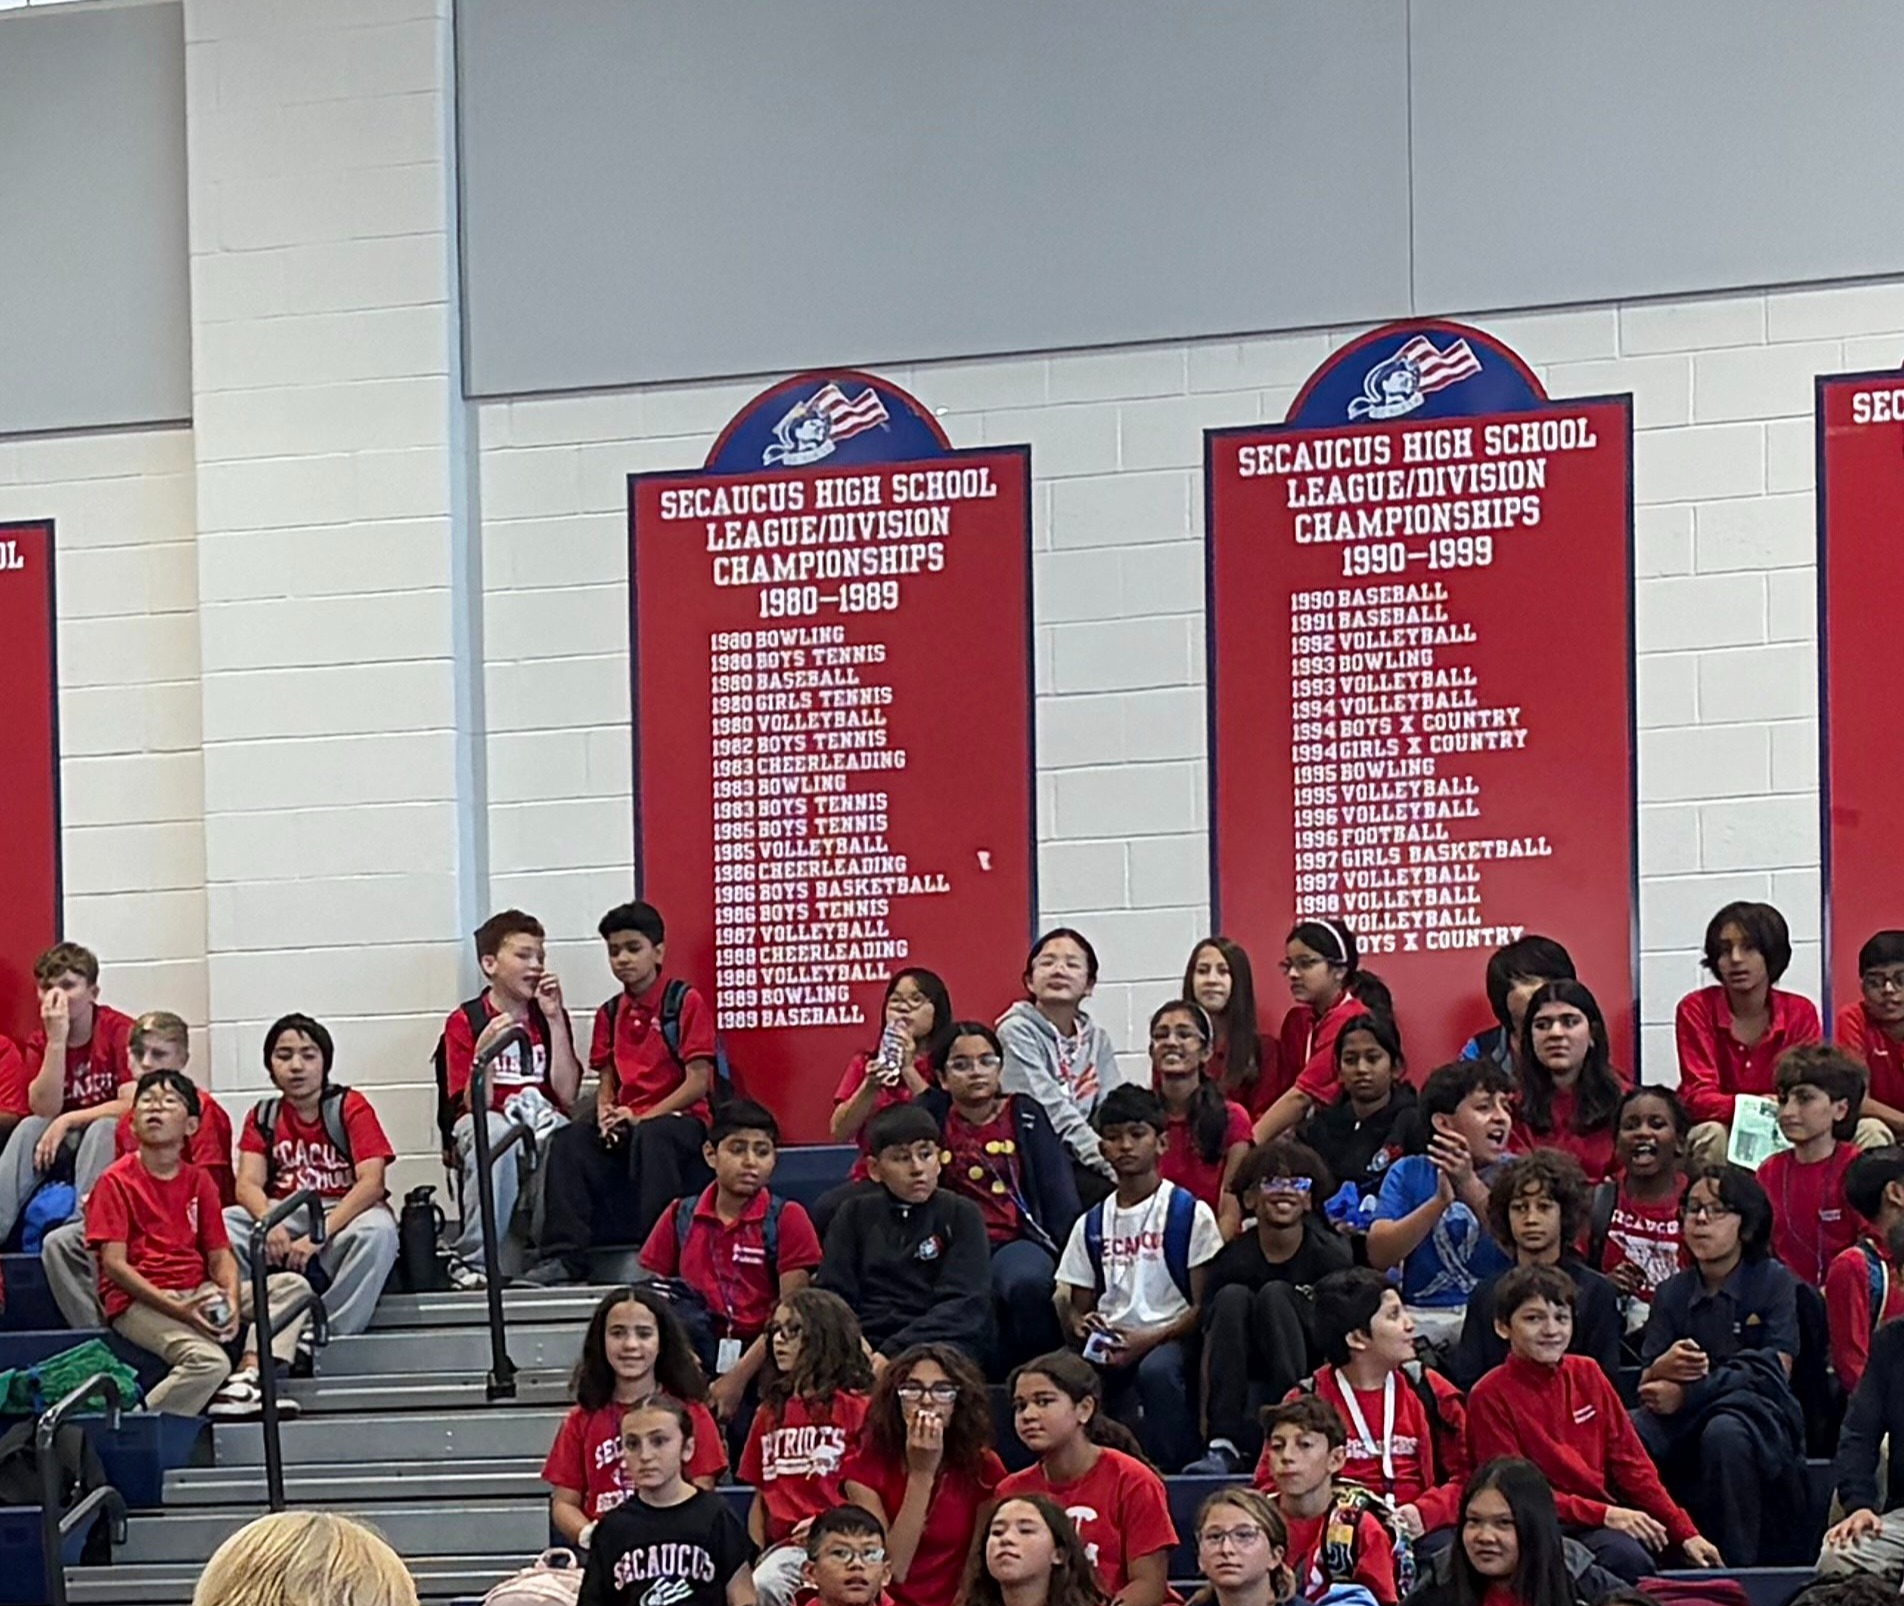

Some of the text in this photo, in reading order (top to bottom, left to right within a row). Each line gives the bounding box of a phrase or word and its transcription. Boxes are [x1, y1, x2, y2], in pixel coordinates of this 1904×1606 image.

[1238, 419, 1597, 477] SECAUCUS HIGH SCHOOL
[660, 469, 997, 520] SECAUCUS HIGH SCHOOL
[1287, 458, 1547, 509] LEAGUE/DIVISION
[706, 506, 951, 552] LEAGUE/DIVISION
[1295, 495, 1540, 544] CHAMPIONSHIPS
[713, 542, 944, 586] CHAMPIONSHIPS
[1338, 603, 1449, 630] BASEBALL
[1338, 623, 1477, 651] VOLLEYBALL
[1339, 716, 1392, 739] BOYS
[1399, 714, 1415, 734] X
[1422, 706, 1521, 732] COUNTRY
[1340, 846, 1402, 868] GIRLS
[1408, 836, 1553, 864] BASKETBALL
[613, 1542, 716, 1590] SECAUCUS
